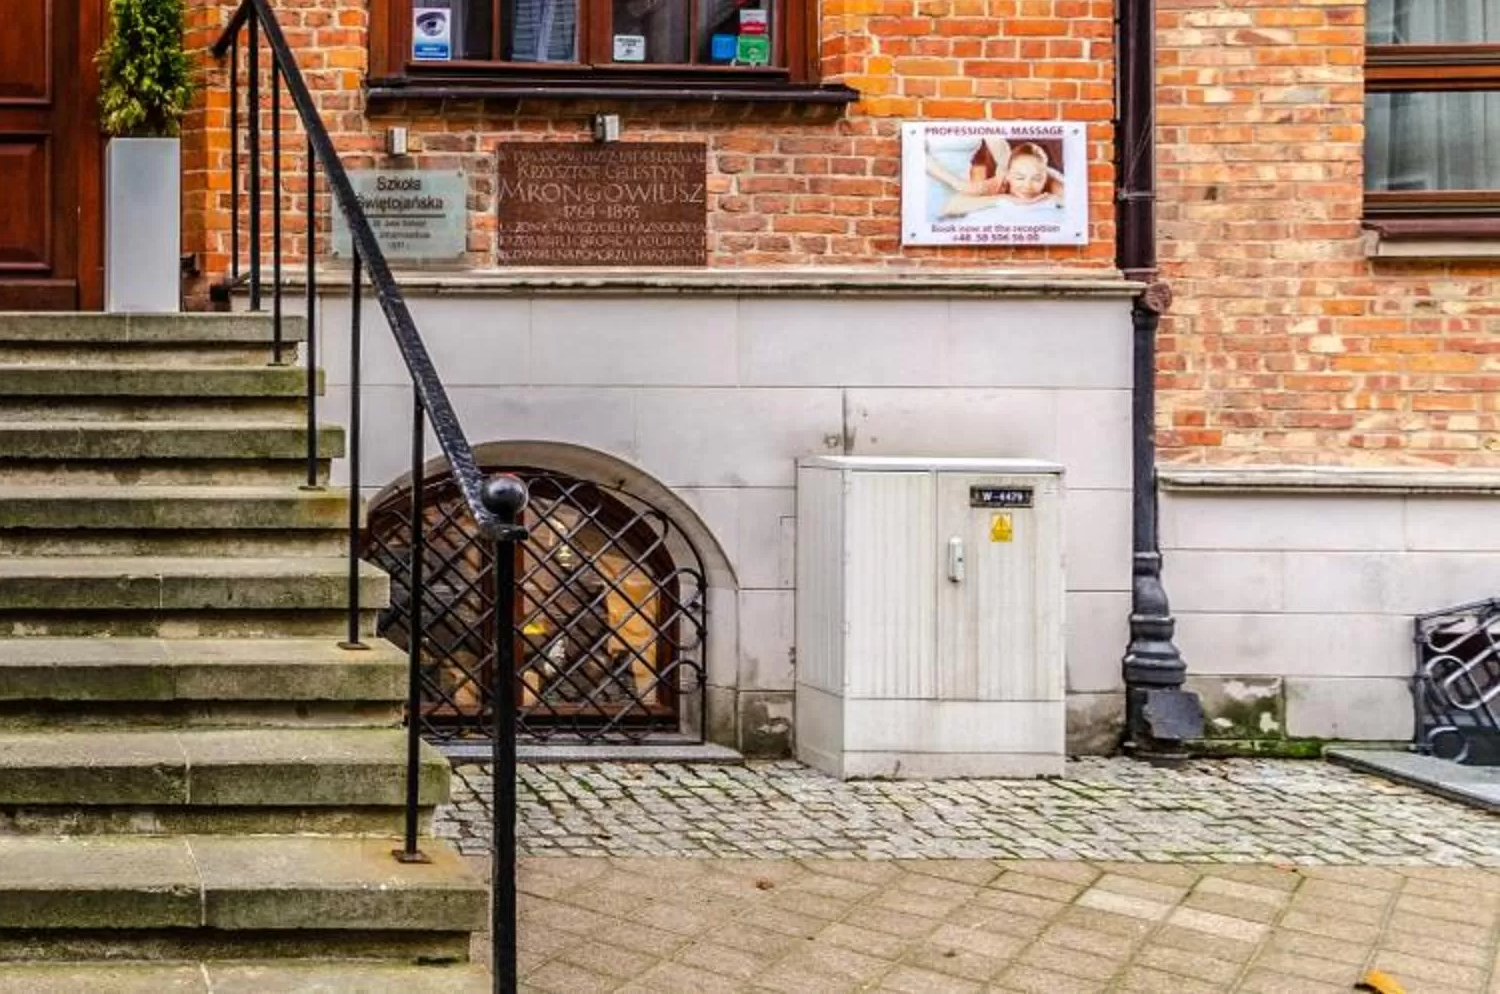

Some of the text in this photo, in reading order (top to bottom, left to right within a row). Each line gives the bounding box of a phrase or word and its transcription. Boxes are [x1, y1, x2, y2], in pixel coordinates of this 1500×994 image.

[925, 125, 1065, 136] PROFESSIONAL MASSAGE
[605, 163, 685, 179] CELESTYN
[376, 176, 422, 191] Szkoła
[499, 179, 704, 204] MRONGOWIUSZ
[931, 224, 1061, 235] Book now at the reception
